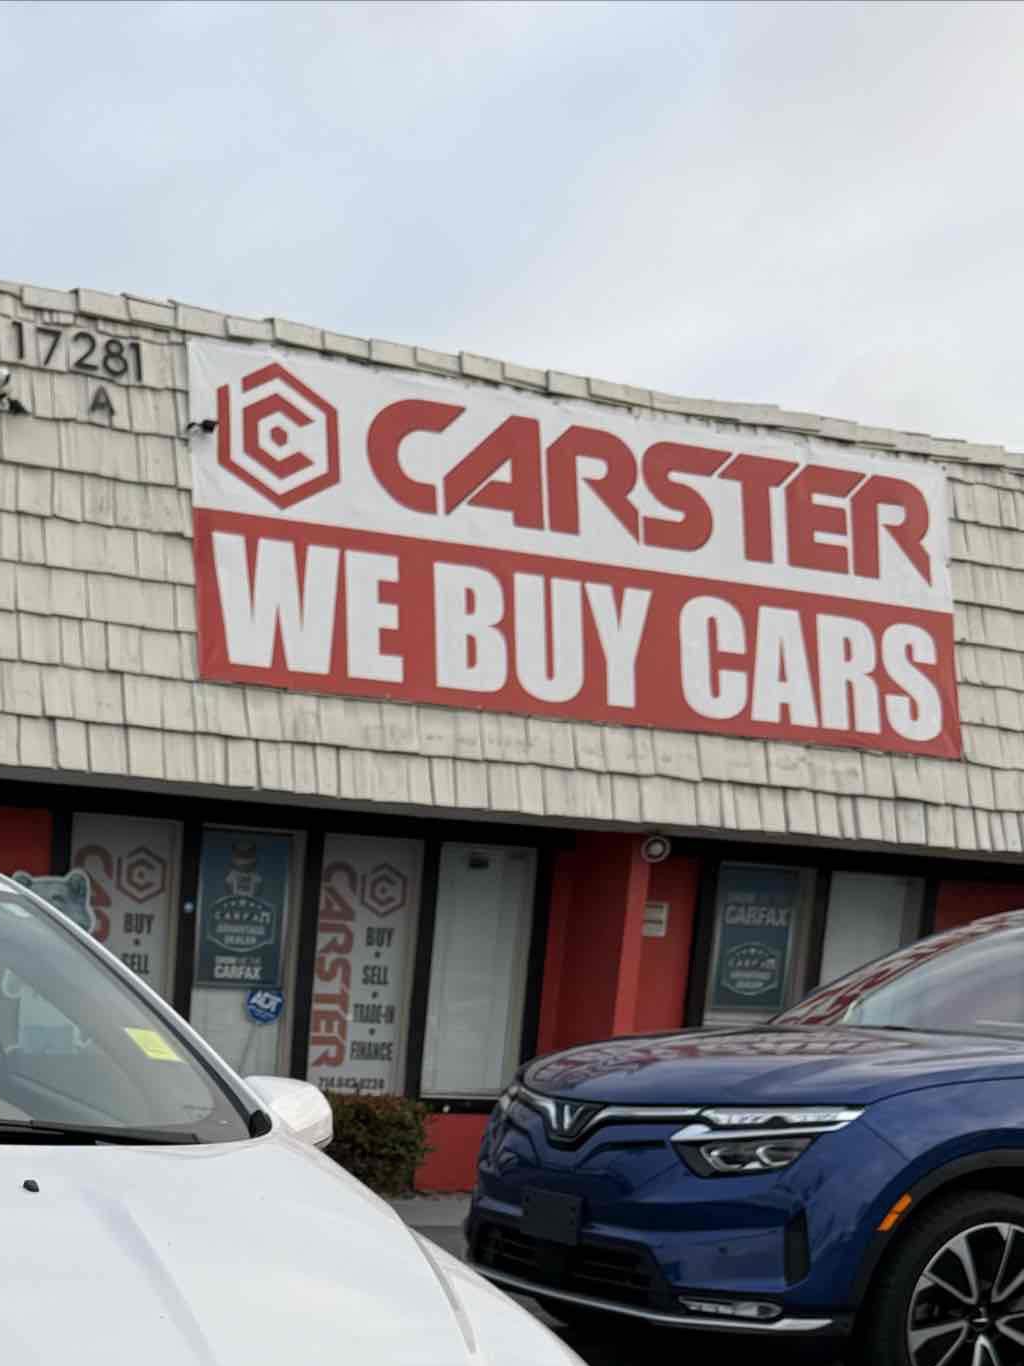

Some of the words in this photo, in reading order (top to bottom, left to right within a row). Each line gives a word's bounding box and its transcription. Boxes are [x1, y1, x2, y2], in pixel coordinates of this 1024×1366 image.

[11, 320, 143, 382] 17281
[89, 386, 115, 416] A
[366, 398, 933, 588] CARSTER
[211, 530, 405, 683] WE
[432, 561, 653, 709] BUY
[679, 595, 943, 742] CARS
[123, 912, 154, 934] BUY
[725, 903, 788, 926] CARFAX
[365, 927, 395, 947] BUY
[213, 965, 263, 980] CARFAX
[311, 860, 359, 1068] CARSTER
[362, 965, 389, 986] SELL
[249, 990, 282, 1012] ADT
[351, 1003, 395, 1025] TRADE-IN
[349, 1041, 393, 1061] FINANCE
